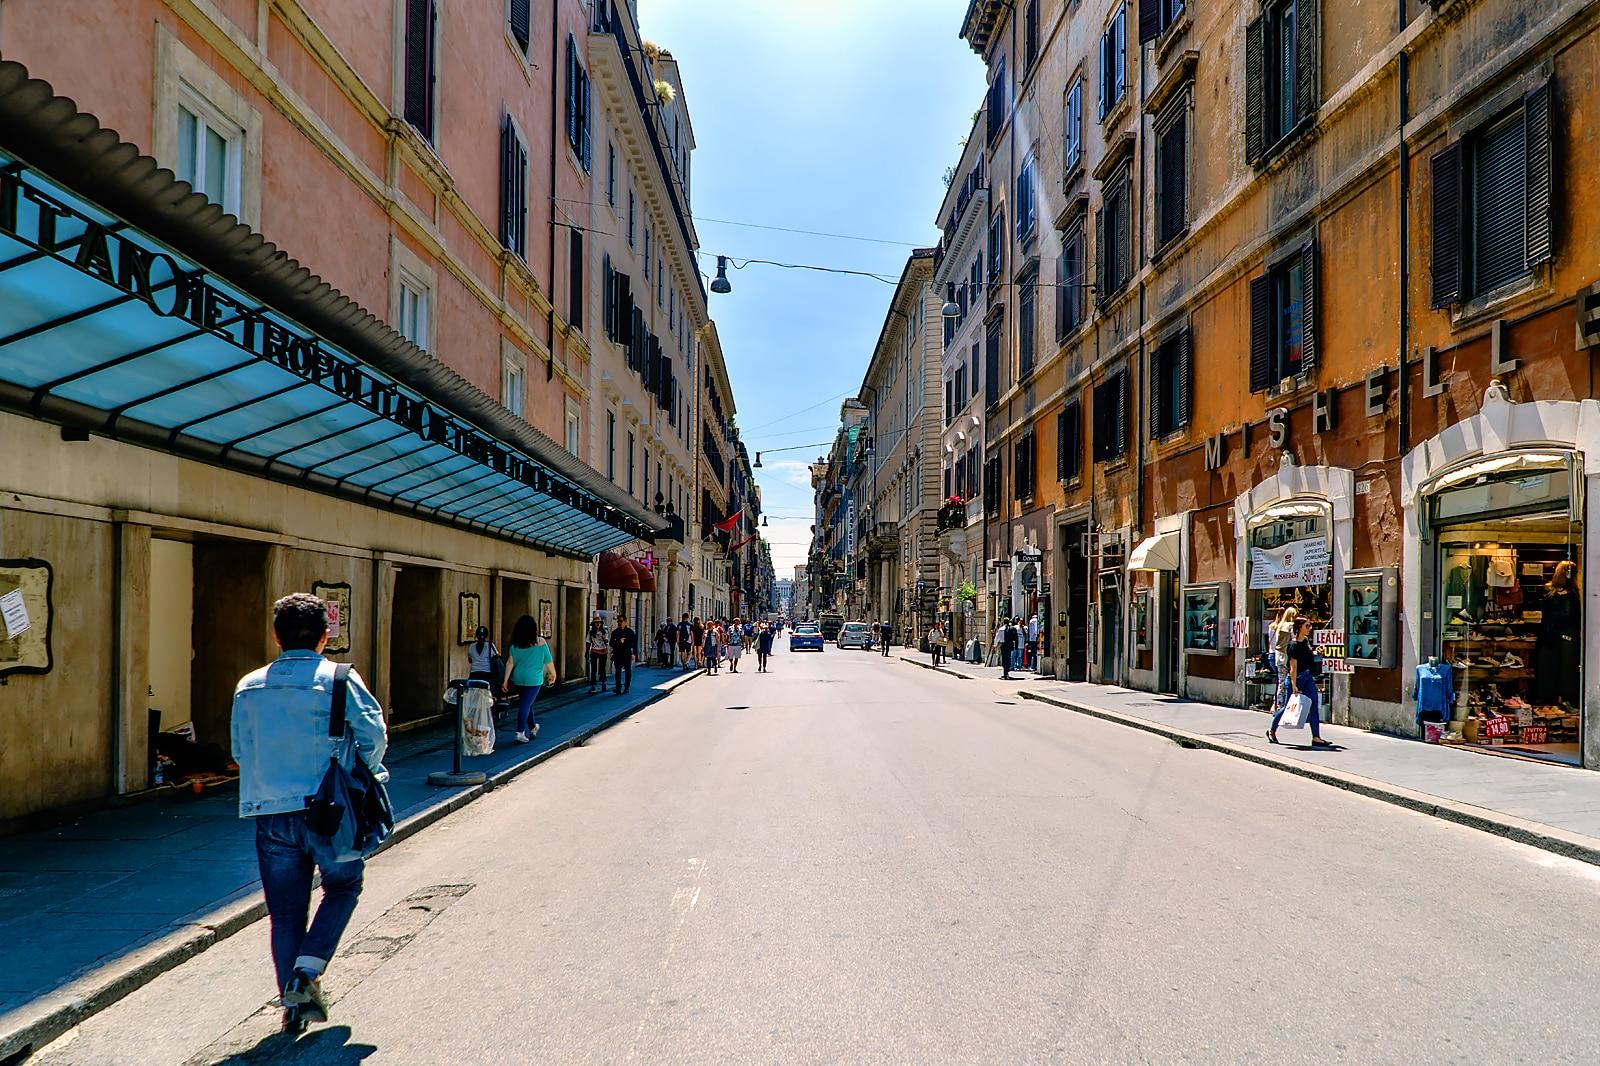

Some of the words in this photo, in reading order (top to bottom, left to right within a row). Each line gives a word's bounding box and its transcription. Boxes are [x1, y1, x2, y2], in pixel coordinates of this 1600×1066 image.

[1205, 285, 1600, 473] MISHELLE
[1328, 660, 1351, 672] PELLE
[1486, 718, 1502, 726] TUTTO
